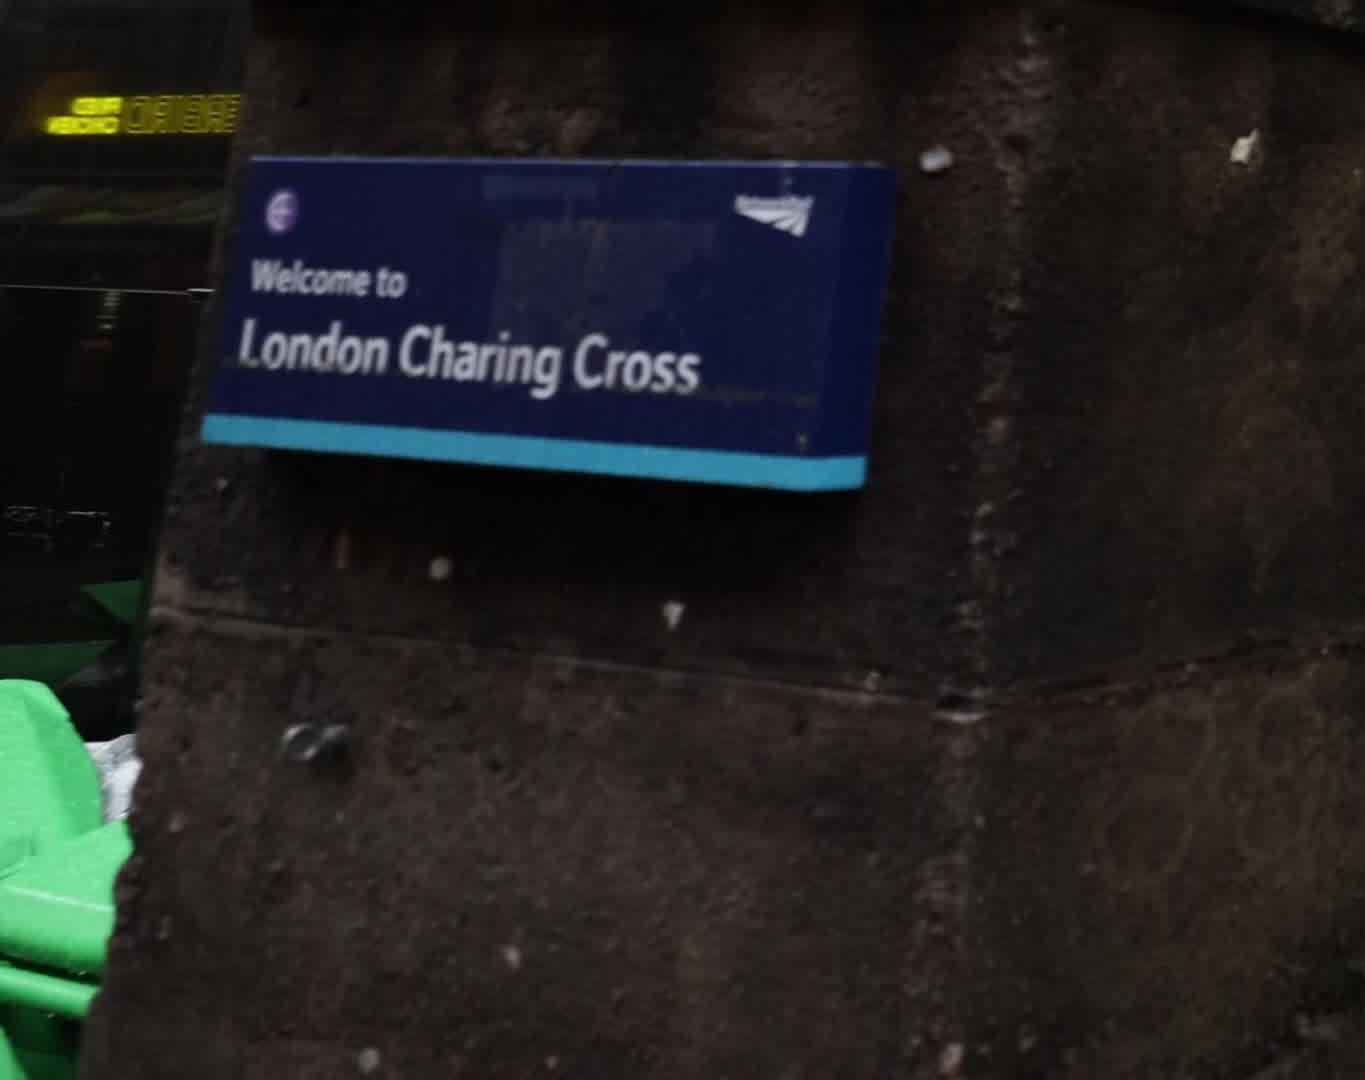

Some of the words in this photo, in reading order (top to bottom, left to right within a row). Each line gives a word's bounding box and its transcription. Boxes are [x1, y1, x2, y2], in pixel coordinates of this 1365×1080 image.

[251, 259, 370, 297] Welcome
[377, 268, 406, 299] to
[239, 318, 388, 375] London
[399, 324, 562, 400] Charing
[574, 334, 701, 394] Cross
